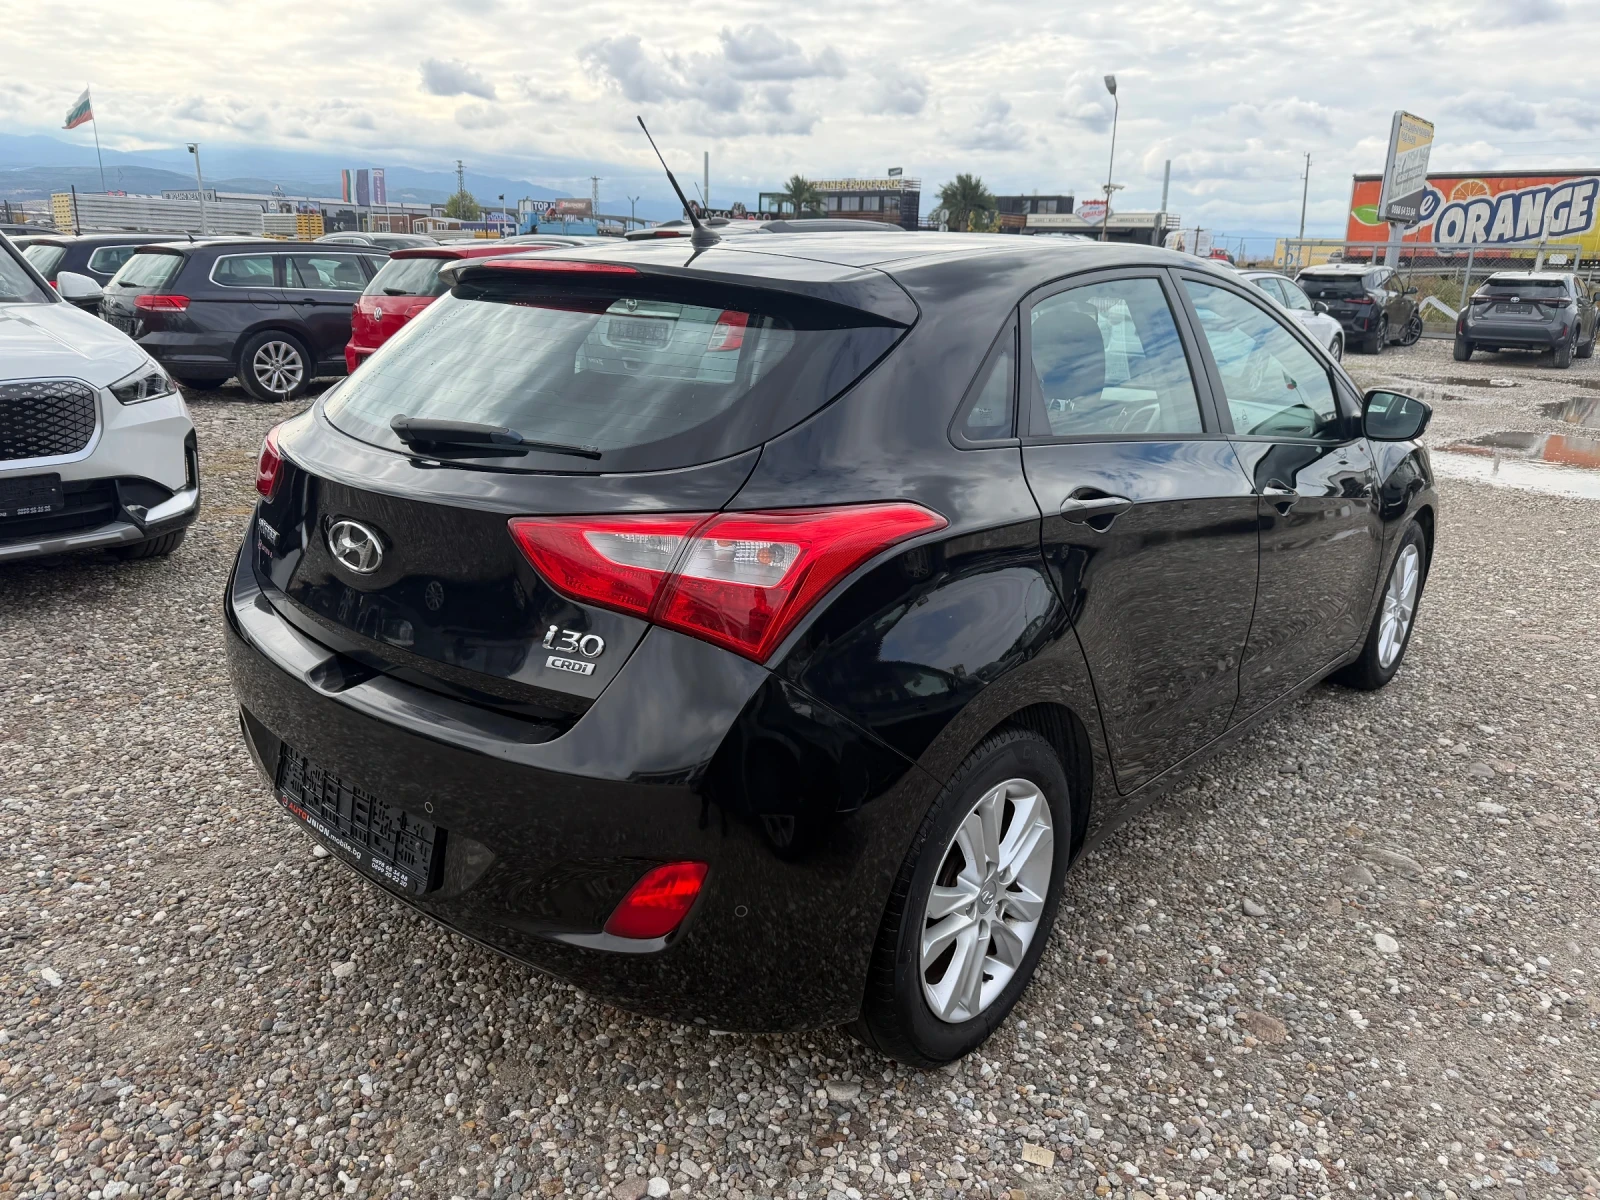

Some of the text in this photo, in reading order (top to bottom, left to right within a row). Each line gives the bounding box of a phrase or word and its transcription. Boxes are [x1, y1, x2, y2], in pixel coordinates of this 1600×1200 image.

[1437, 181, 1596, 248] ORANGE
[542, 624, 604, 658] i30
[552, 658, 588, 673] CRDi
